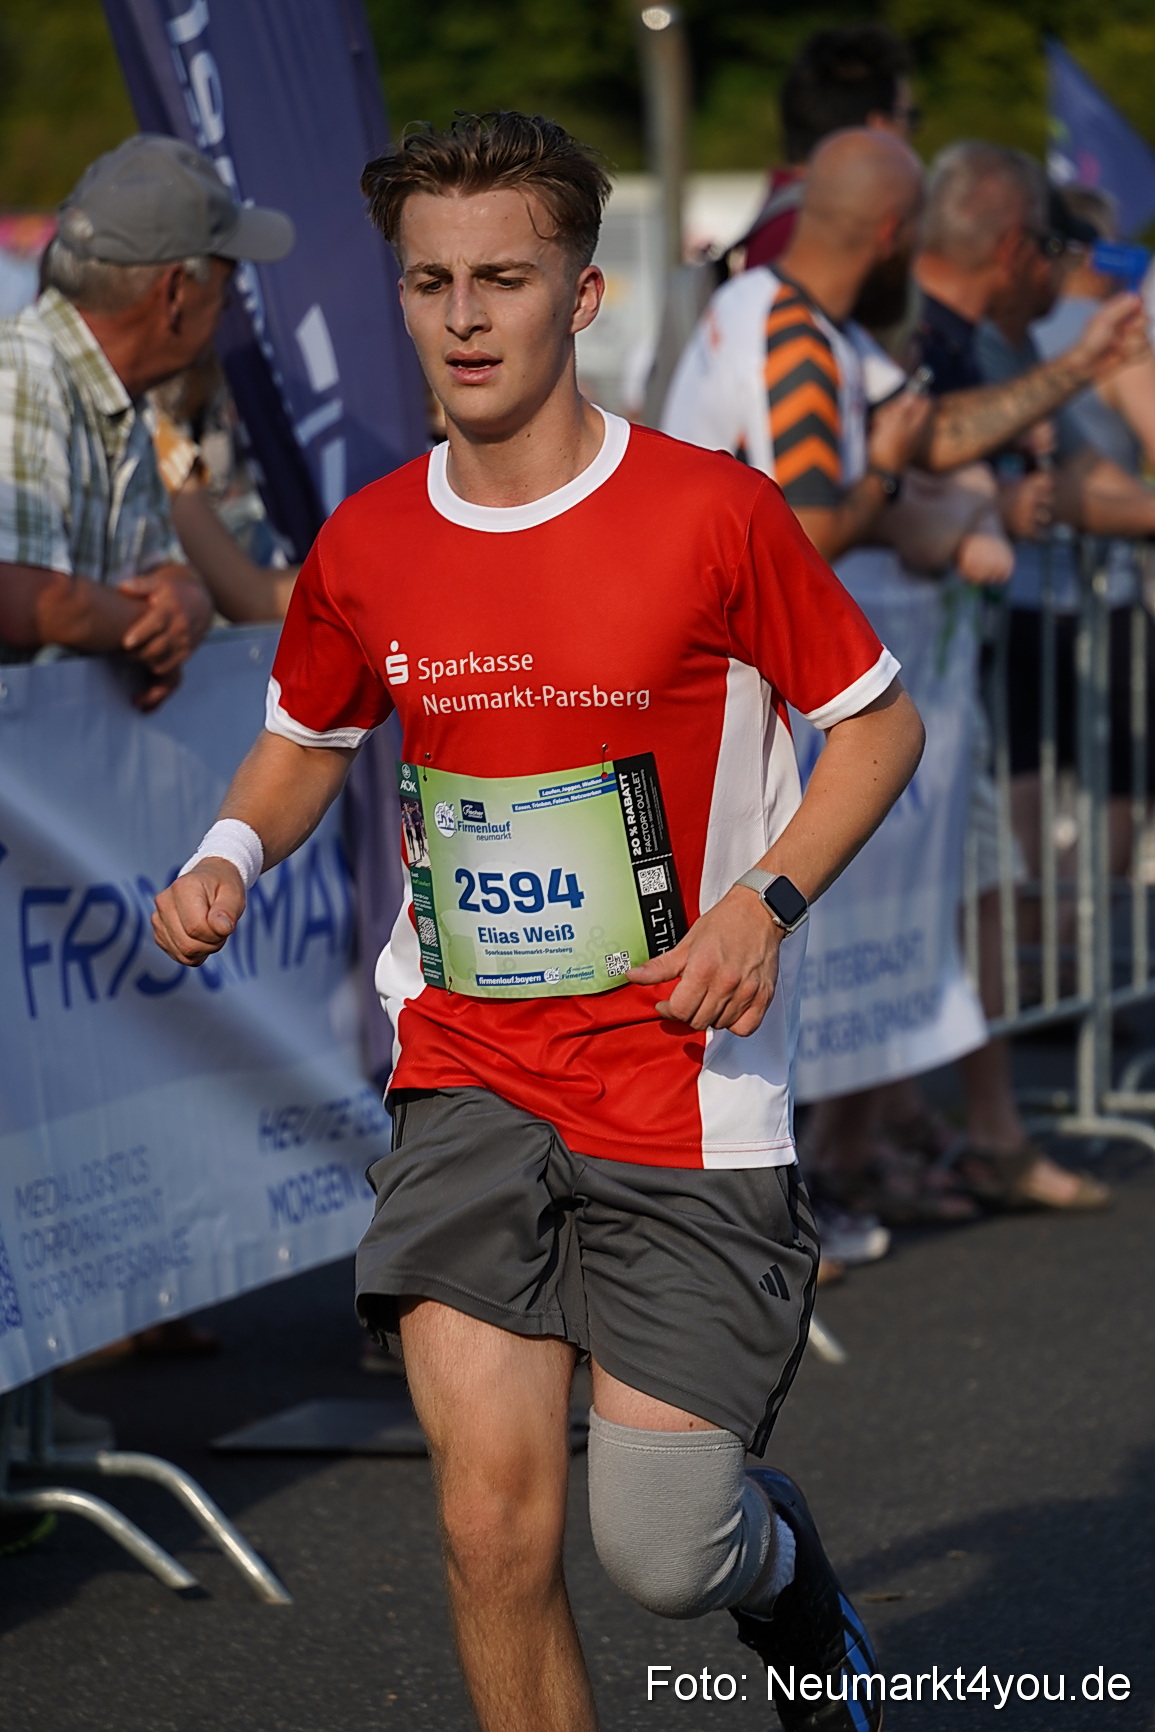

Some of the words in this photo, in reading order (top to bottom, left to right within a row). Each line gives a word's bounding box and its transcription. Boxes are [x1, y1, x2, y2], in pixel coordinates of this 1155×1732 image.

[417, 651, 534, 684] Sparkasse
[421, 685, 651, 716] Neumarkt-Parsberg
[400, 780, 417, 793] AOK
[631, 771, 645, 809] OUTLET
[618, 773, 637, 826] RABATT
[457, 820, 511, 834] Firmenlauf
[476, 832, 512, 842] neumarkt
[639, 810, 653, 853] FACTORY
[630, 837, 642, 857] 20
[454, 868, 585, 915] 2594
[477, 926, 521, 944] Elias
[522, 924, 576, 943] Weiß
[484, 948, 513, 956] Sparkasse
[513, 947, 573, 956] Neumarkt-Parsberg
[478, 974, 542, 985] firmenlauf.bayern
